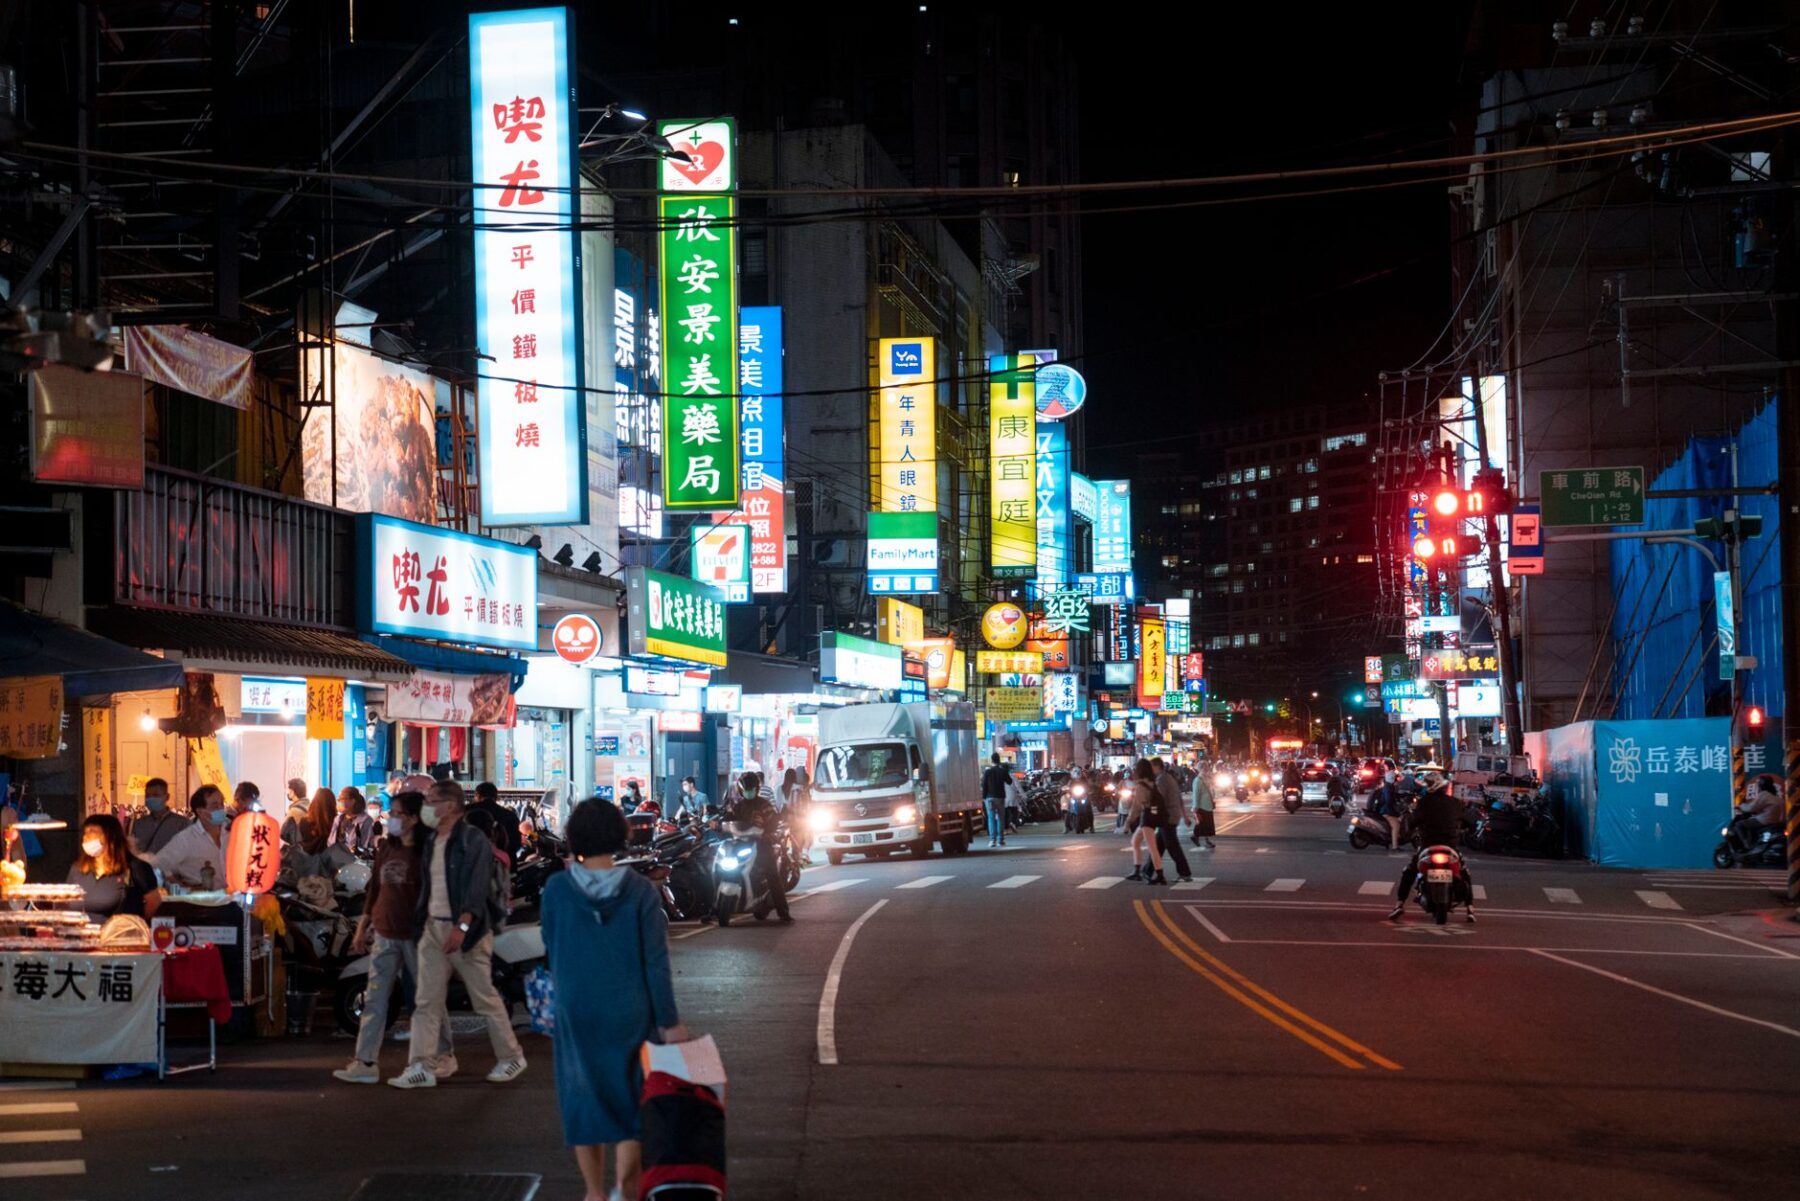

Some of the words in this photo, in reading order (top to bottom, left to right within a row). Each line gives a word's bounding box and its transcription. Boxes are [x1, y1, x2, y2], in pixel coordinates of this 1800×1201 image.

[493, 96, 545, 207] 喫尤
[511, 245, 540, 447] 平價鐵板燒
[675, 206, 722, 495] 欣安景美藥局
[899, 395, 916, 511] 年青人眼鏡
[998, 415, 1030, 522] 康宜庭
[1552, 471, 1632, 489] 車前路
[393, 547, 449, 616] 喫尤
[755, 572, 776, 587] 2F
[871, 549, 935, 561] FamilyMart
[663, 590, 723, 641] 欣安景美藥局
[1044, 588, 1090, 633] 藥
[0, 961, 134, 1002] 莓大福
